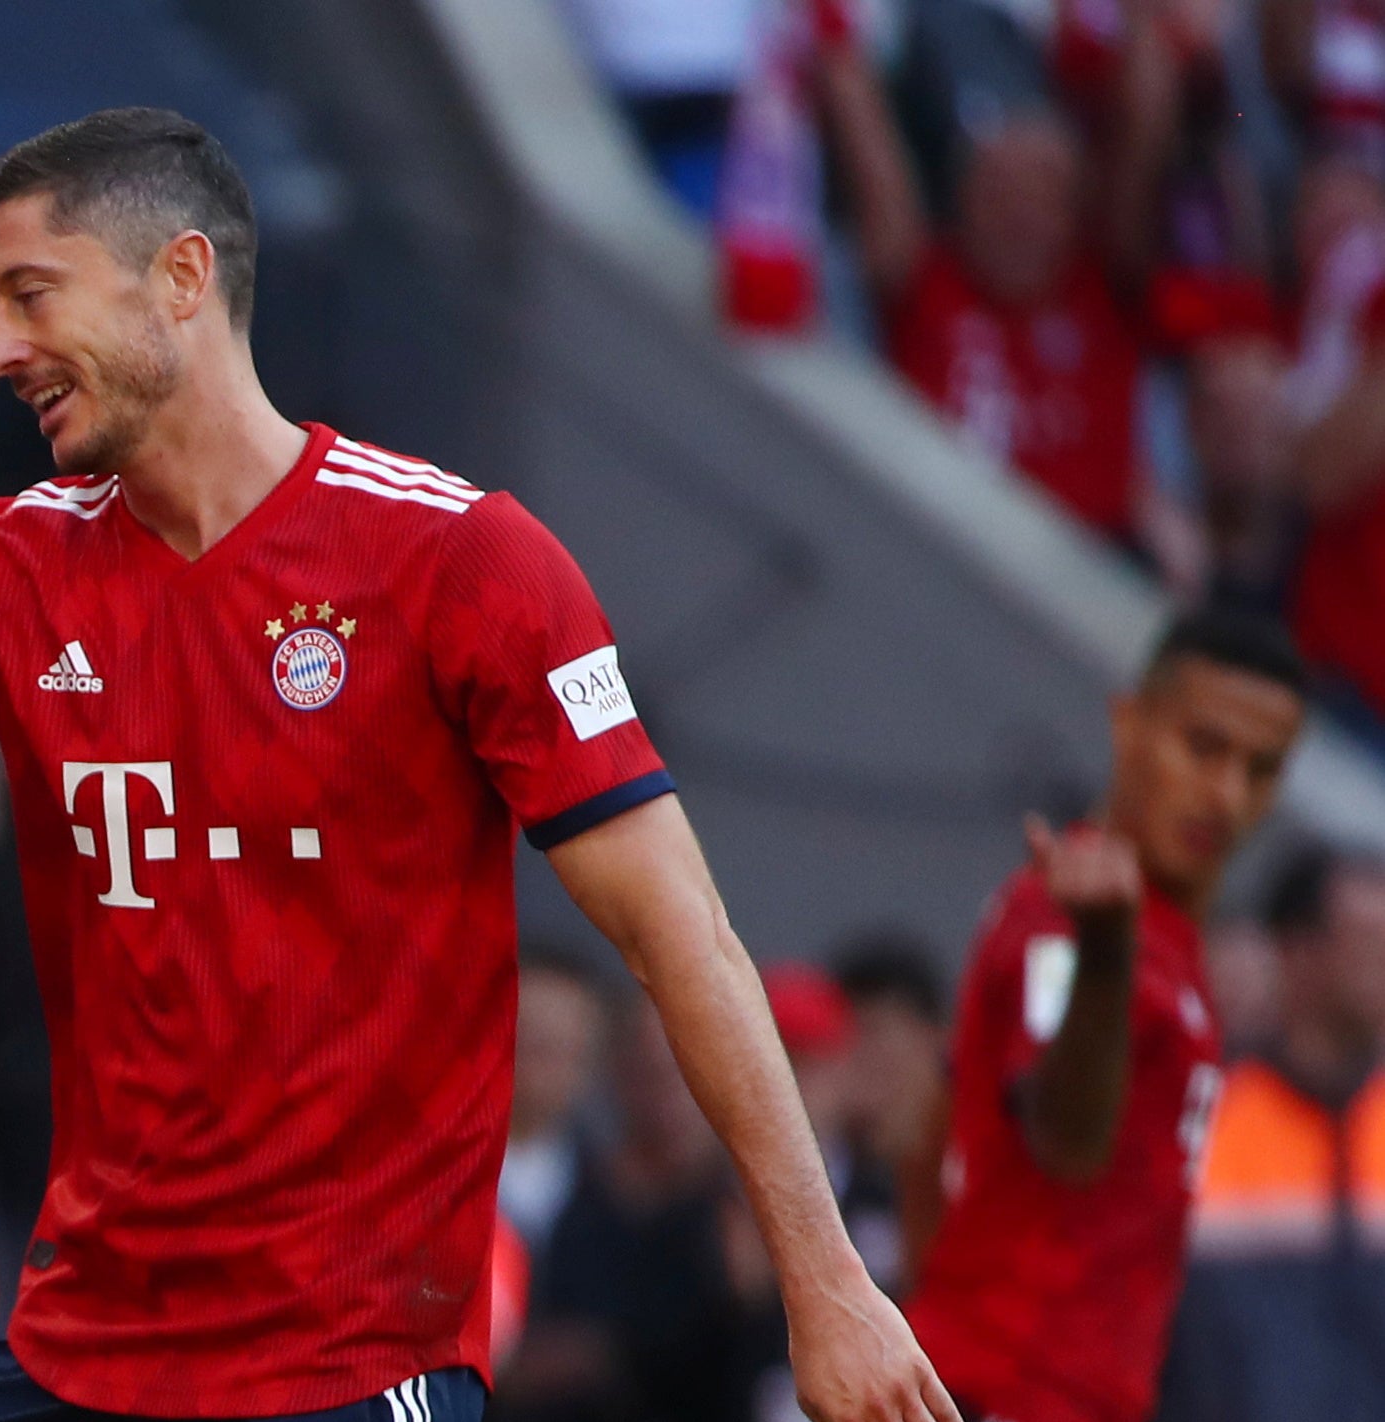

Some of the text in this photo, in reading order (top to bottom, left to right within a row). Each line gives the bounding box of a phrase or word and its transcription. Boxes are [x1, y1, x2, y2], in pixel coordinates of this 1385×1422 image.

[279, 633, 340, 664] FC BAYERN
[37, 673, 104, 693] adidas
